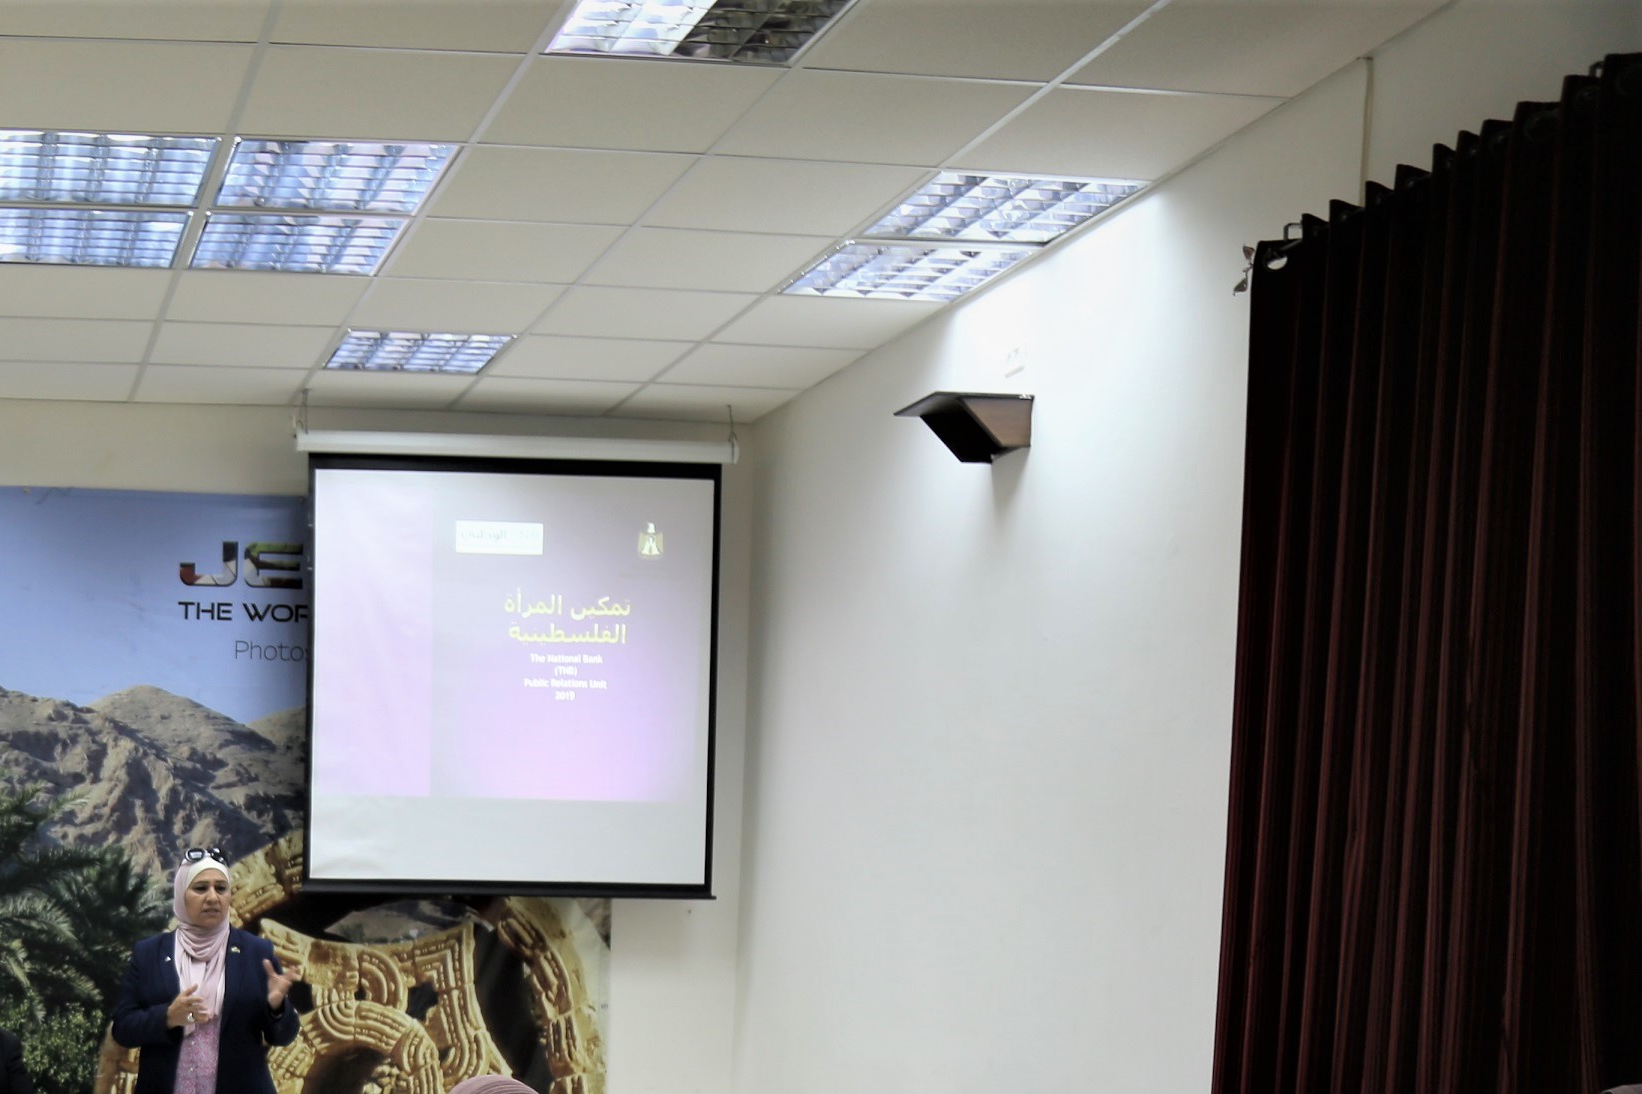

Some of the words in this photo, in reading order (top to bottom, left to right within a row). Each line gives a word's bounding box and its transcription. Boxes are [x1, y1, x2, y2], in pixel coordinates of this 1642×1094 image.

[504, 587, 563, 618] المرأة
[178, 601, 233, 621] THE
[508, 620, 627, 646] الفلسطينية
[530, 653, 546, 663] The
[547, 654, 581, 664] National
[583, 655, 603, 664] Bank
[554, 666, 578, 676] (TNB)
[523, 678, 549, 688] Public
[550, 679, 588, 688] Relations
[589, 680, 607, 689] Unit
[555, 691, 576, 701] 2019
